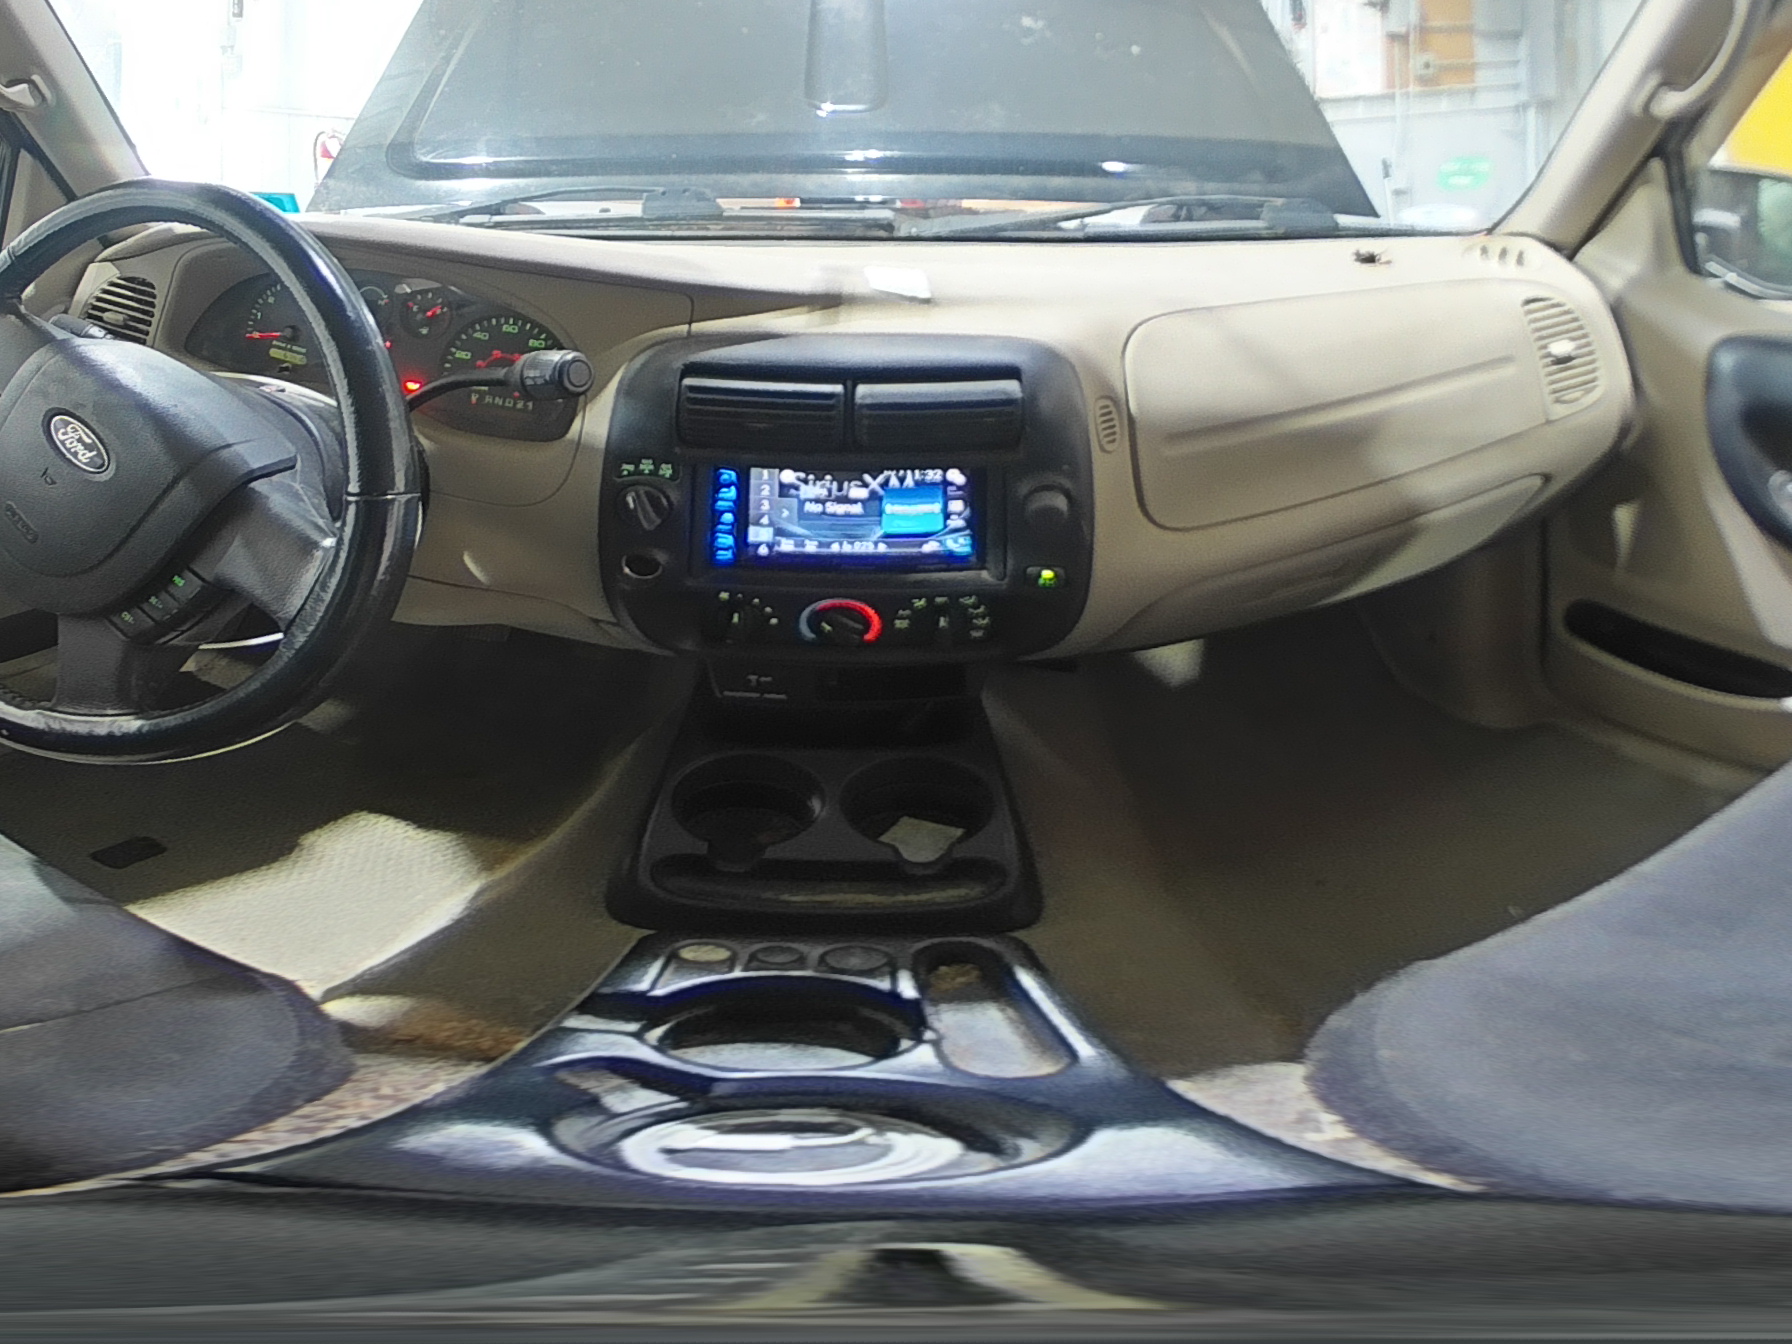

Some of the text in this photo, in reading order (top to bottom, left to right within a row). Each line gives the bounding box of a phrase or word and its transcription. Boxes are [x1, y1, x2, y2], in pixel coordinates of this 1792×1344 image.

[473, 332, 489, 340] 40
[57, 424, 97, 463] Ford
[762, 469, 769, 481] 1
[760, 484, 770, 496] 2
[760, 499, 770, 511] 3
[804, 501, 865, 515] No Signal
[759, 514, 770, 525] 4
[757, 543, 769, 556] 6
